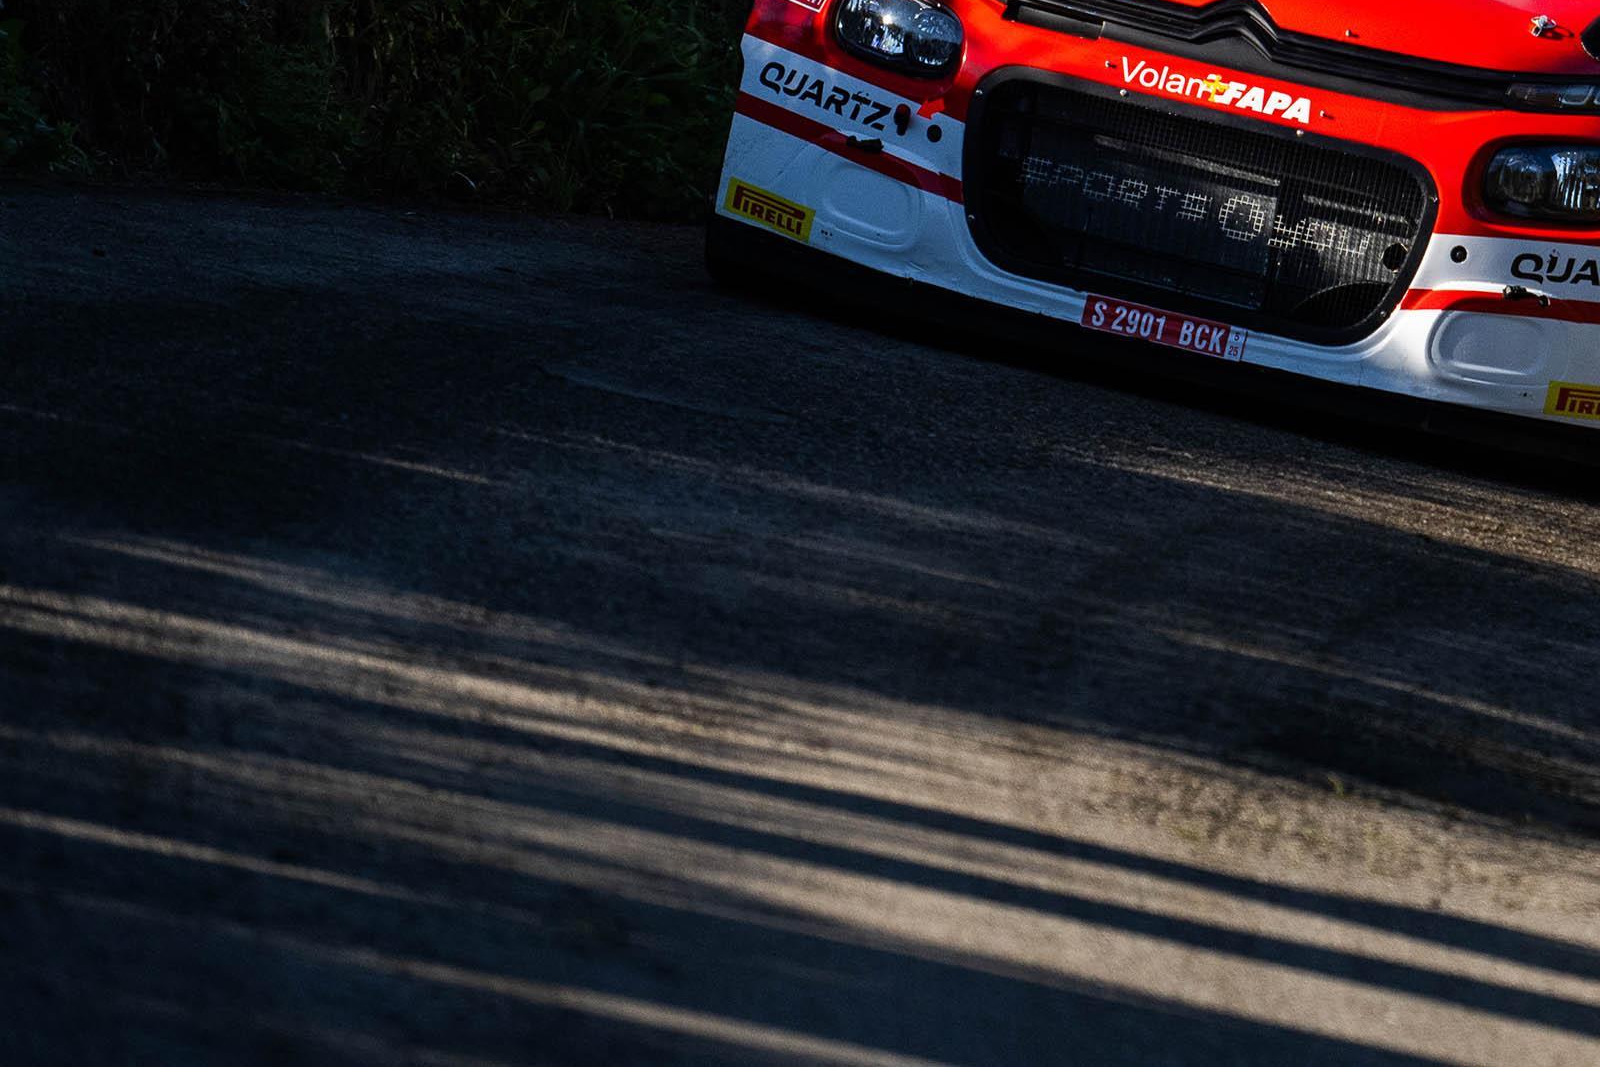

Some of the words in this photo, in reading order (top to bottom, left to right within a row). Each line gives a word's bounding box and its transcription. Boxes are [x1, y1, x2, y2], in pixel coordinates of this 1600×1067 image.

[759, 61, 892, 132] QUARTZ
[1223, 81, 1311, 124] FAPA
[732, 184, 805, 236] PIRELLI
[1091, 301, 1107, 327] S
[1111, 305, 1167, 341] 2901
[1178, 320, 1226, 354] BCK
